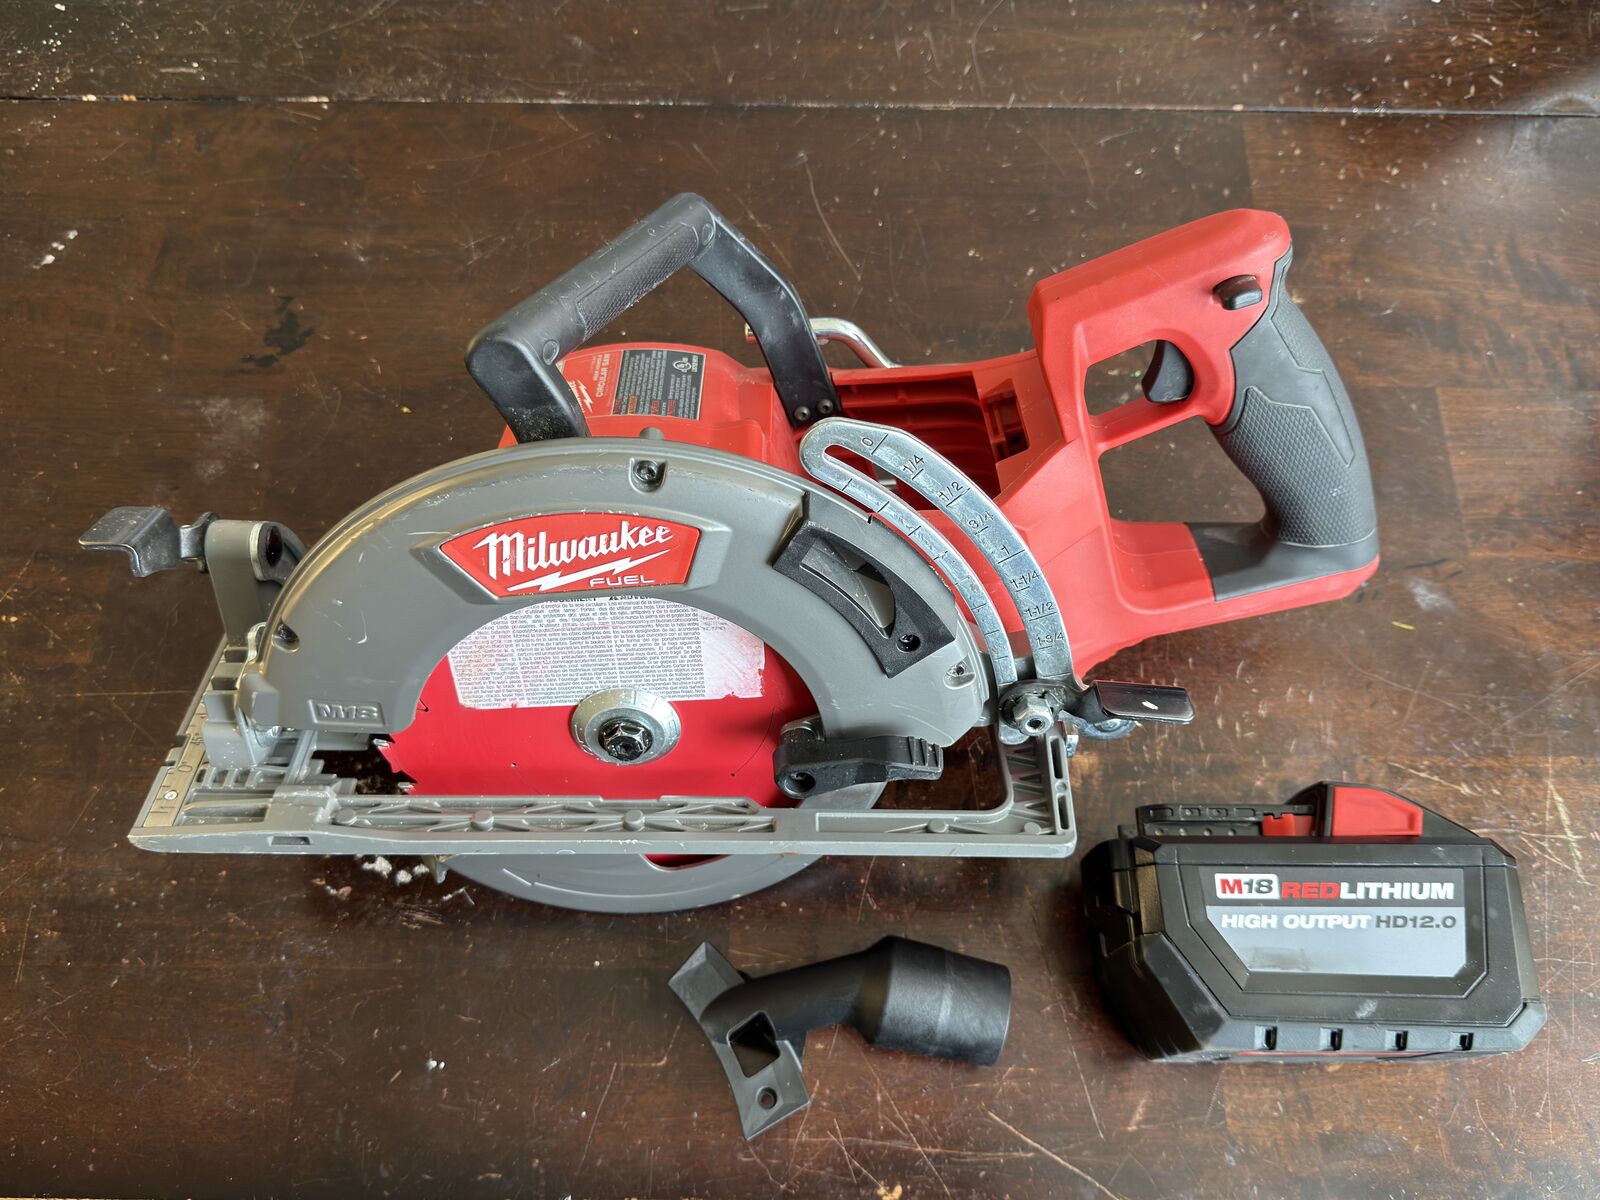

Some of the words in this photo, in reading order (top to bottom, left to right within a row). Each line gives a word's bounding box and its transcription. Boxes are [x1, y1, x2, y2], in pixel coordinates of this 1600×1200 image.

[595, 367, 609, 398] CIRCULAR
[602, 353, 610, 366] SAW
[861, 437, 874, 447] 0
[903, 454, 924, 474] 1/4
[938, 481, 964, 502] 1/2
[968, 511, 994, 530] 3/4
[472, 520, 675, 581] Milwaukee
[589, 575, 655, 588] FUEL
[1010, 570, 1041, 589] 1-1/4
[1025, 602, 1055, 618] 1-1/2
[316, 703, 380, 720] M18
[1219, 878, 1274, 895] M18
[1281, 881, 1455, 900] REDLITHIUM
[1221, 914, 1278, 929] HIGH
[1283, 914, 1372, 929] OUTPUT
[1375, 915, 1457, 929] HD12.0
